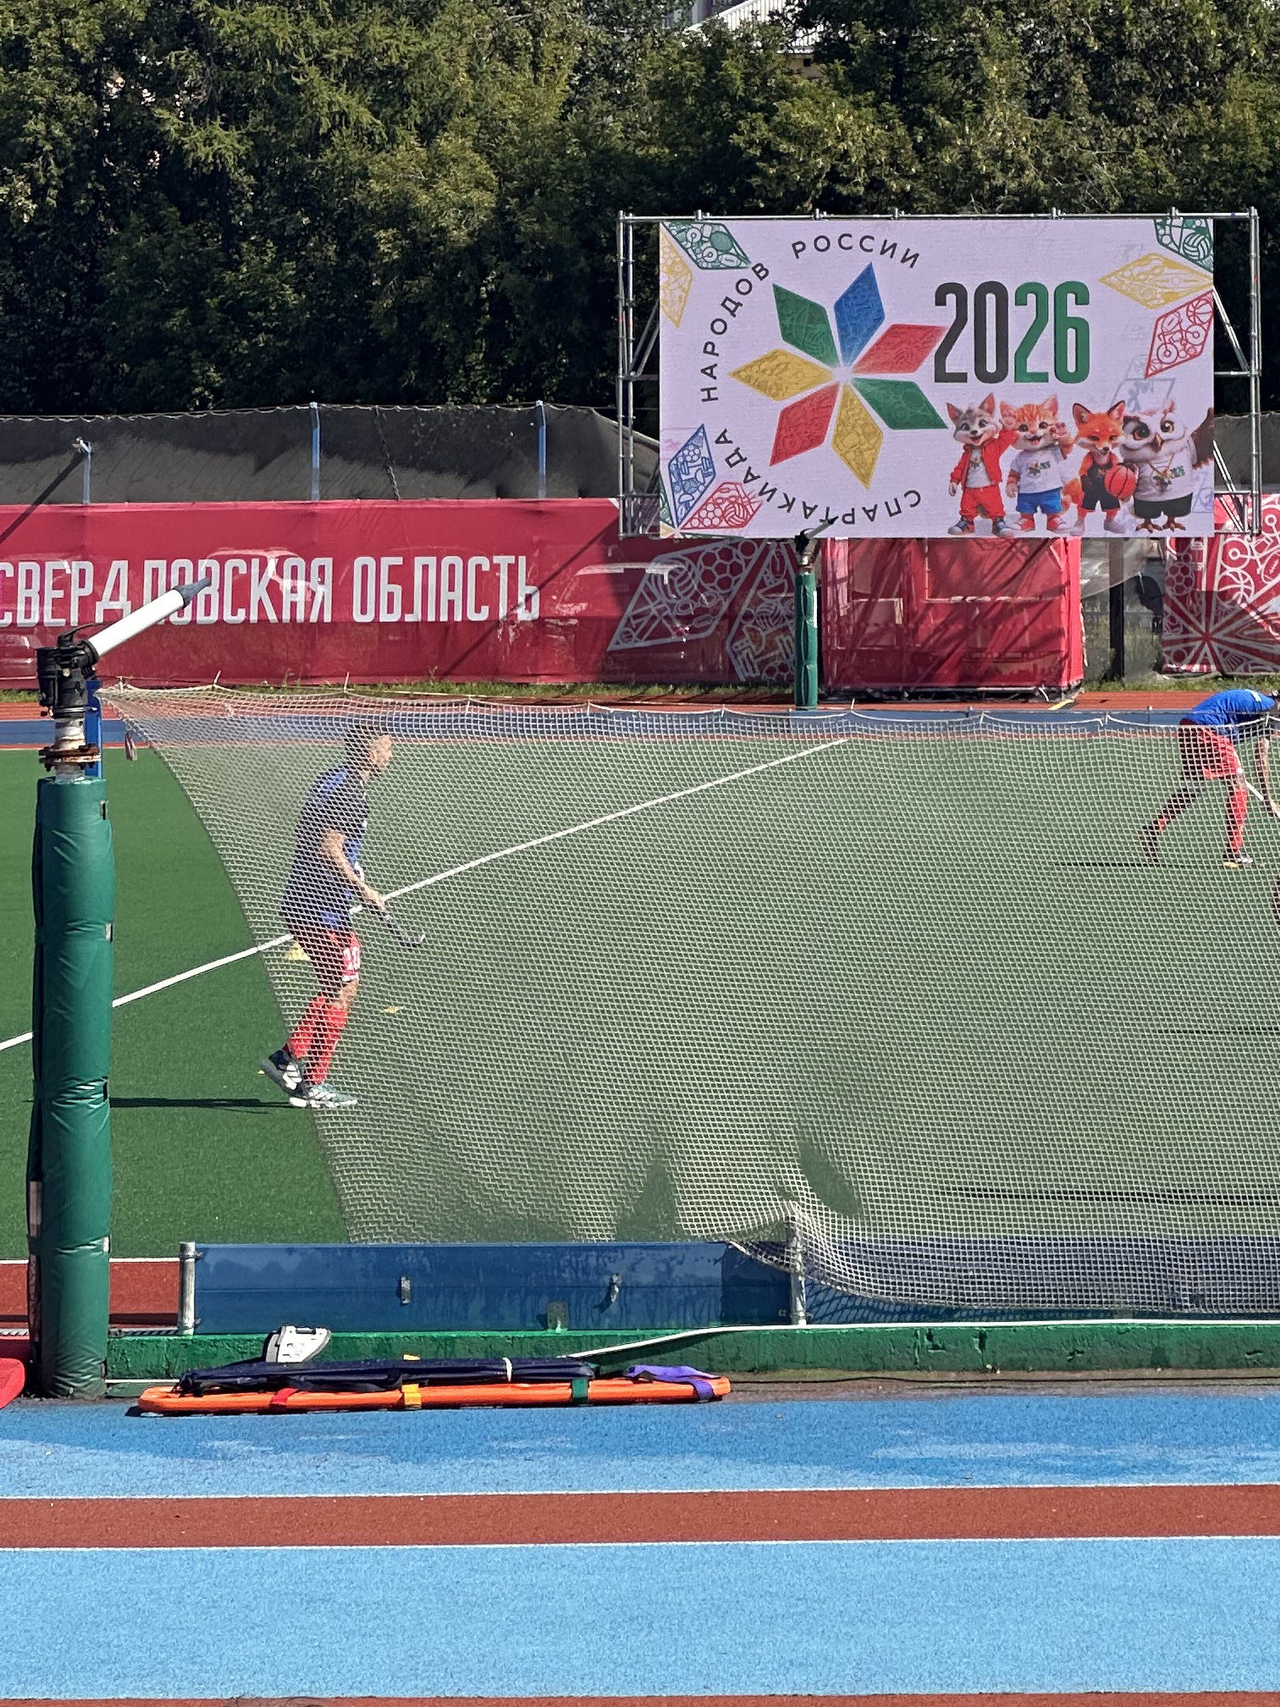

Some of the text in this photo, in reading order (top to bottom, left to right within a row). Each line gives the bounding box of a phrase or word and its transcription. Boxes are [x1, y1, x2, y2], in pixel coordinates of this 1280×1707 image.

[700, 232, 922, 525] СПАРТАКИАДА НАРОДОВ РОССИИ
[933, 280, 1090, 384] 2026
[353, 555, 541, 624] ОБЛАСТЬ
